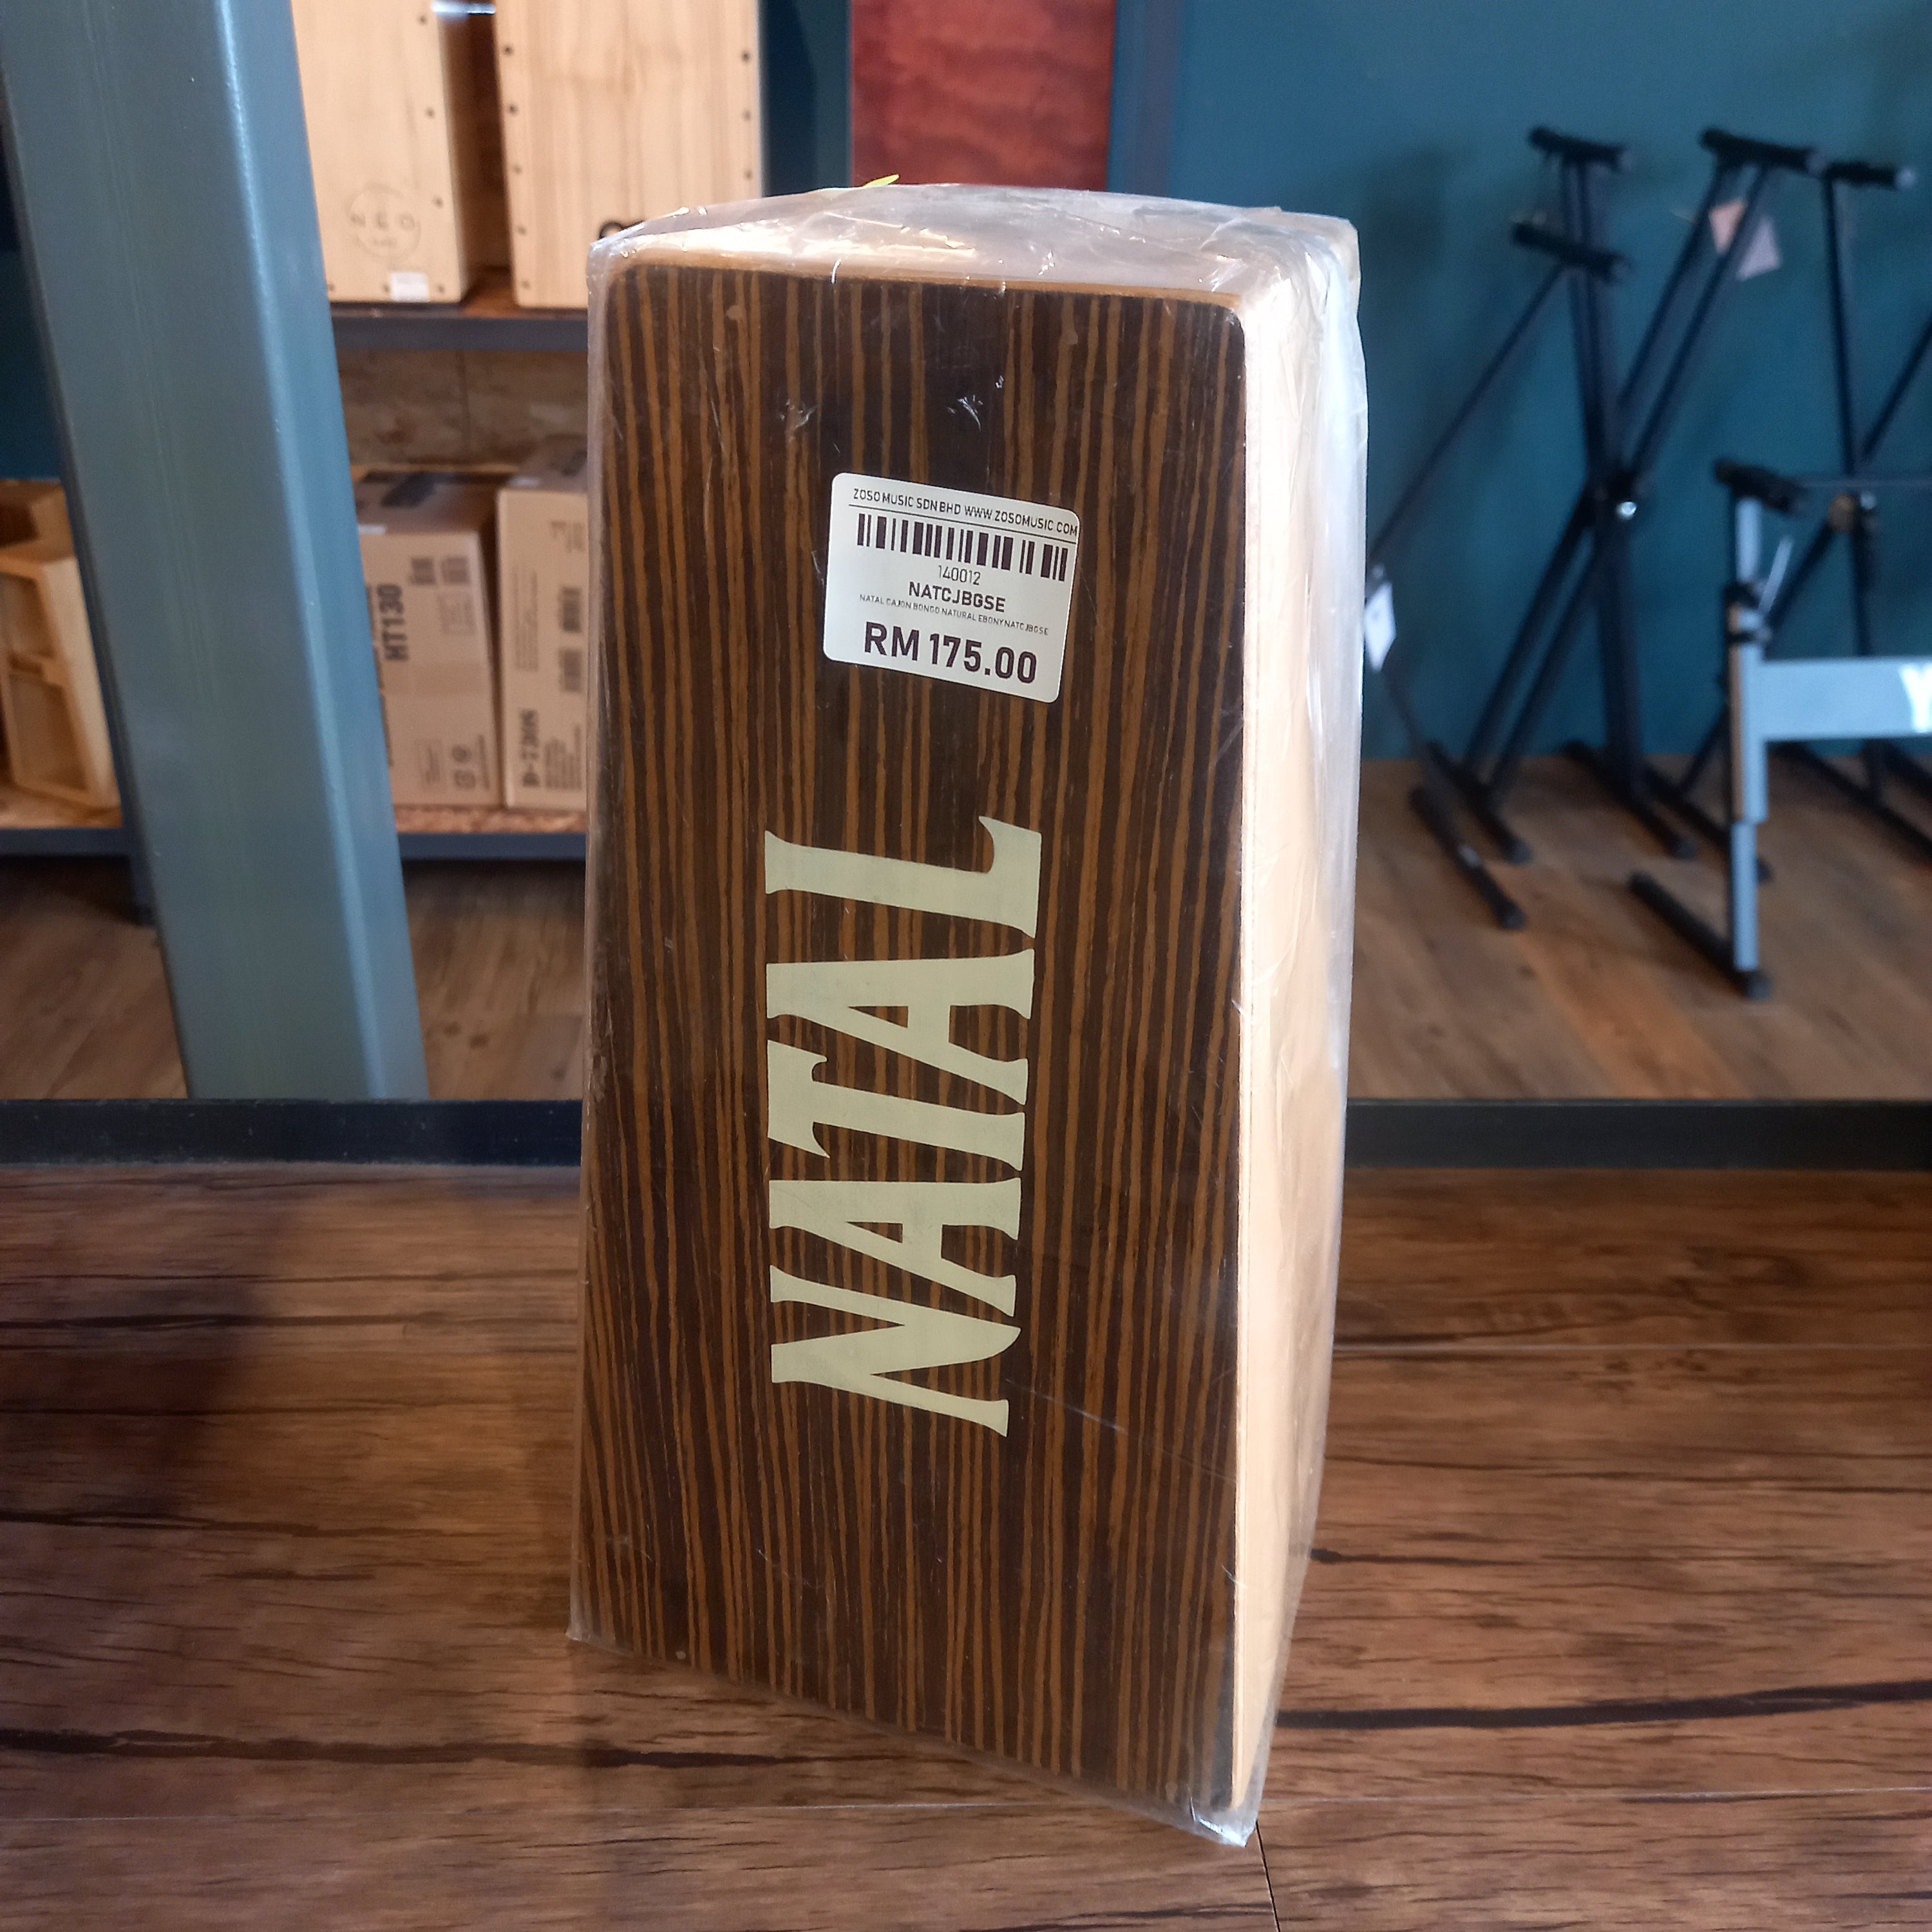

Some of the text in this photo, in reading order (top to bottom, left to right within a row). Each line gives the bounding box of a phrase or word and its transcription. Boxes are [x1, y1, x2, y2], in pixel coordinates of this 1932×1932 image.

[853, 488, 880, 502] ZOSO
[882, 493, 914, 507] MUSIC
[938, 565, 981, 585] 140012
[860, 594, 885, 605] NATAL
[886, 598, 911, 609] CAJON
[942, 608, 976, 621] NATURAL
[909, 582, 1006, 612] NATCJBGSE
[864, 621, 1037, 684] RM 175.00
[764, 815, 1042, 1437] NATAL
